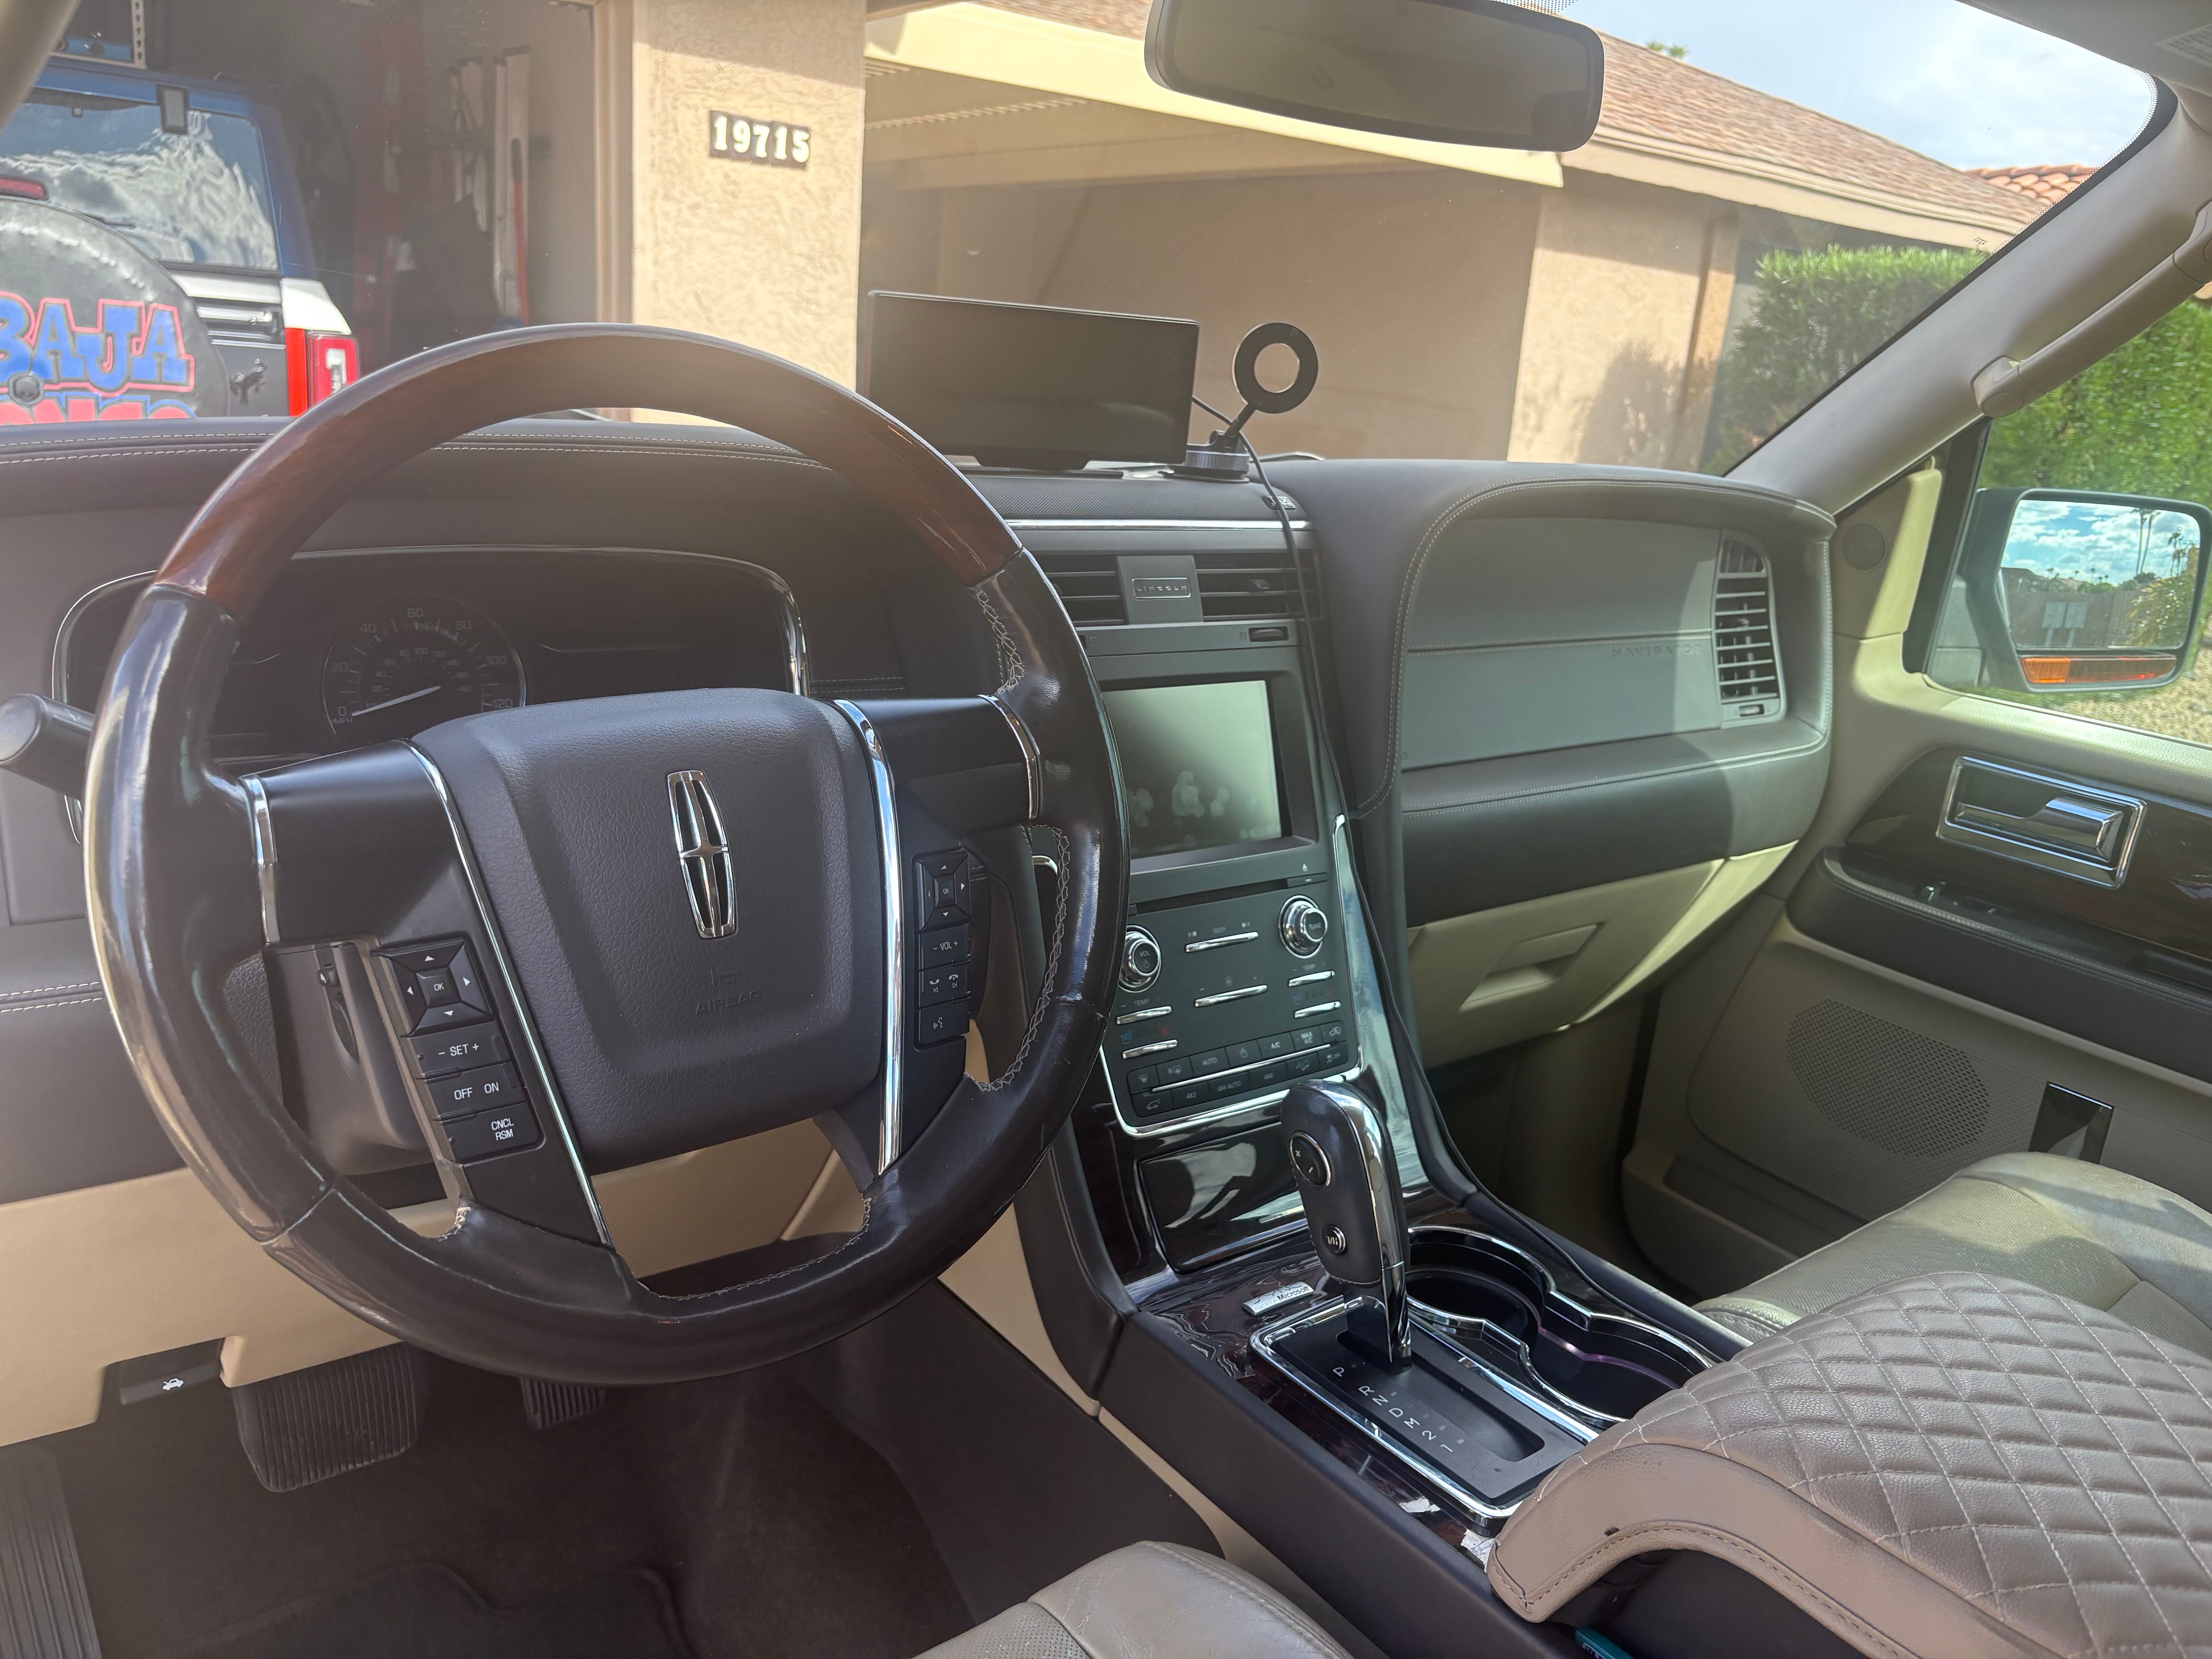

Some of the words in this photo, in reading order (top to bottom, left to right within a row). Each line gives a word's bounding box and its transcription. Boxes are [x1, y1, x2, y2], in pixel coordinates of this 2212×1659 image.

[714, 115, 810, 163] 19715
[407, 608, 424, 618] 60
[360, 622, 377, 634] 40
[486, 655, 507, 665] 100
[331, 662, 348, 672] 20
[492, 699, 513, 709] 120
[940, 941, 952, 950] VOL
[434, 982, 444, 991] OK
[450, 1044, 469, 1056] SET
[1203, 1057, 1218, 1065] AUTO
[454, 1087, 473, 1100] OFF
[484, 1082, 499, 1094] ON
[491, 1118, 514, 1130] CNCL
[496, 1129, 514, 1141] RSM
[1332, 1367, 1345, 1377] P
[1358, 1384, 1375, 1397] R
[1372, 1396, 1389, 1406] N
[1389, 1407, 1403, 1418] D
[1403, 1419, 1420, 1429] M
[1422, 1430, 1437, 1441] 2
[1439, 1444, 1454, 1453] 1
